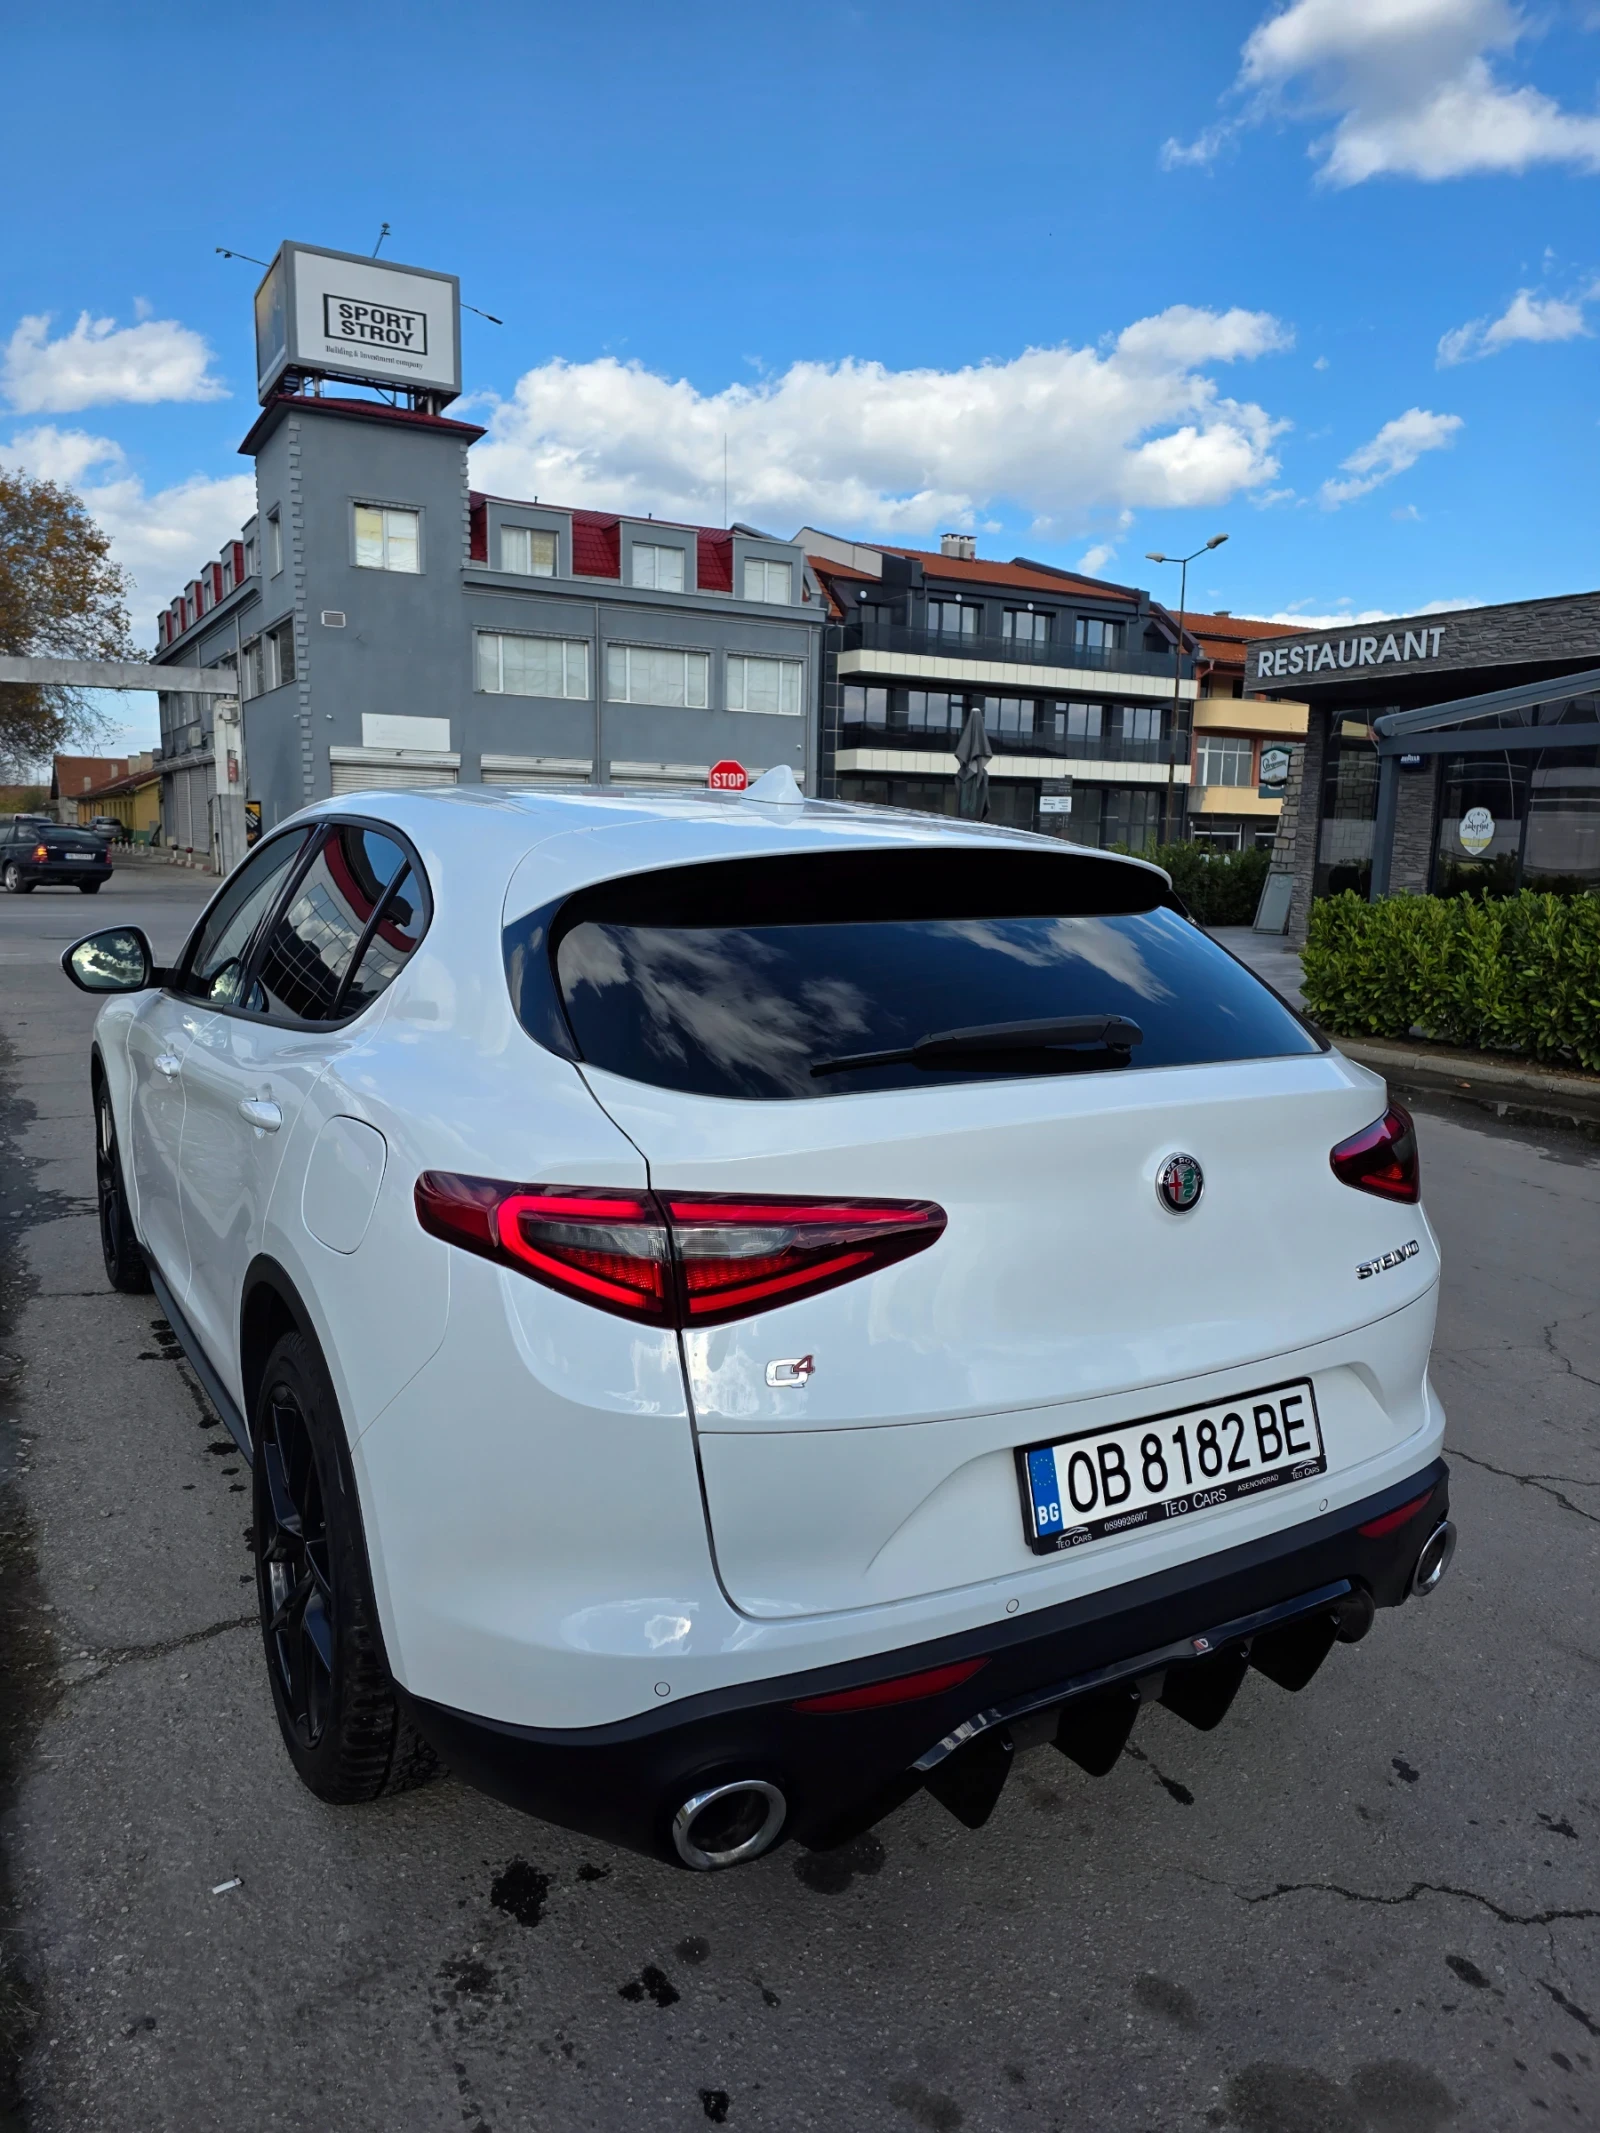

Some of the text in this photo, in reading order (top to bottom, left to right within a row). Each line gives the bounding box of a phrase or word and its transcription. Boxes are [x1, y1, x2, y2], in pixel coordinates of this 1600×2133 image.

[339, 303, 415, 331] SPORT
[341, 320, 414, 346] STROY
[1257, 626, 1446, 678] RESTAURANT
[712, 772, 745, 788] STOP
[1355, 1239, 1420, 1280] STELVIO
[765, 1354, 816, 1389] Q4
[1067, 1395, 1311, 1513] OB 8182 BE
[1037, 1502, 1060, 1526] BG
